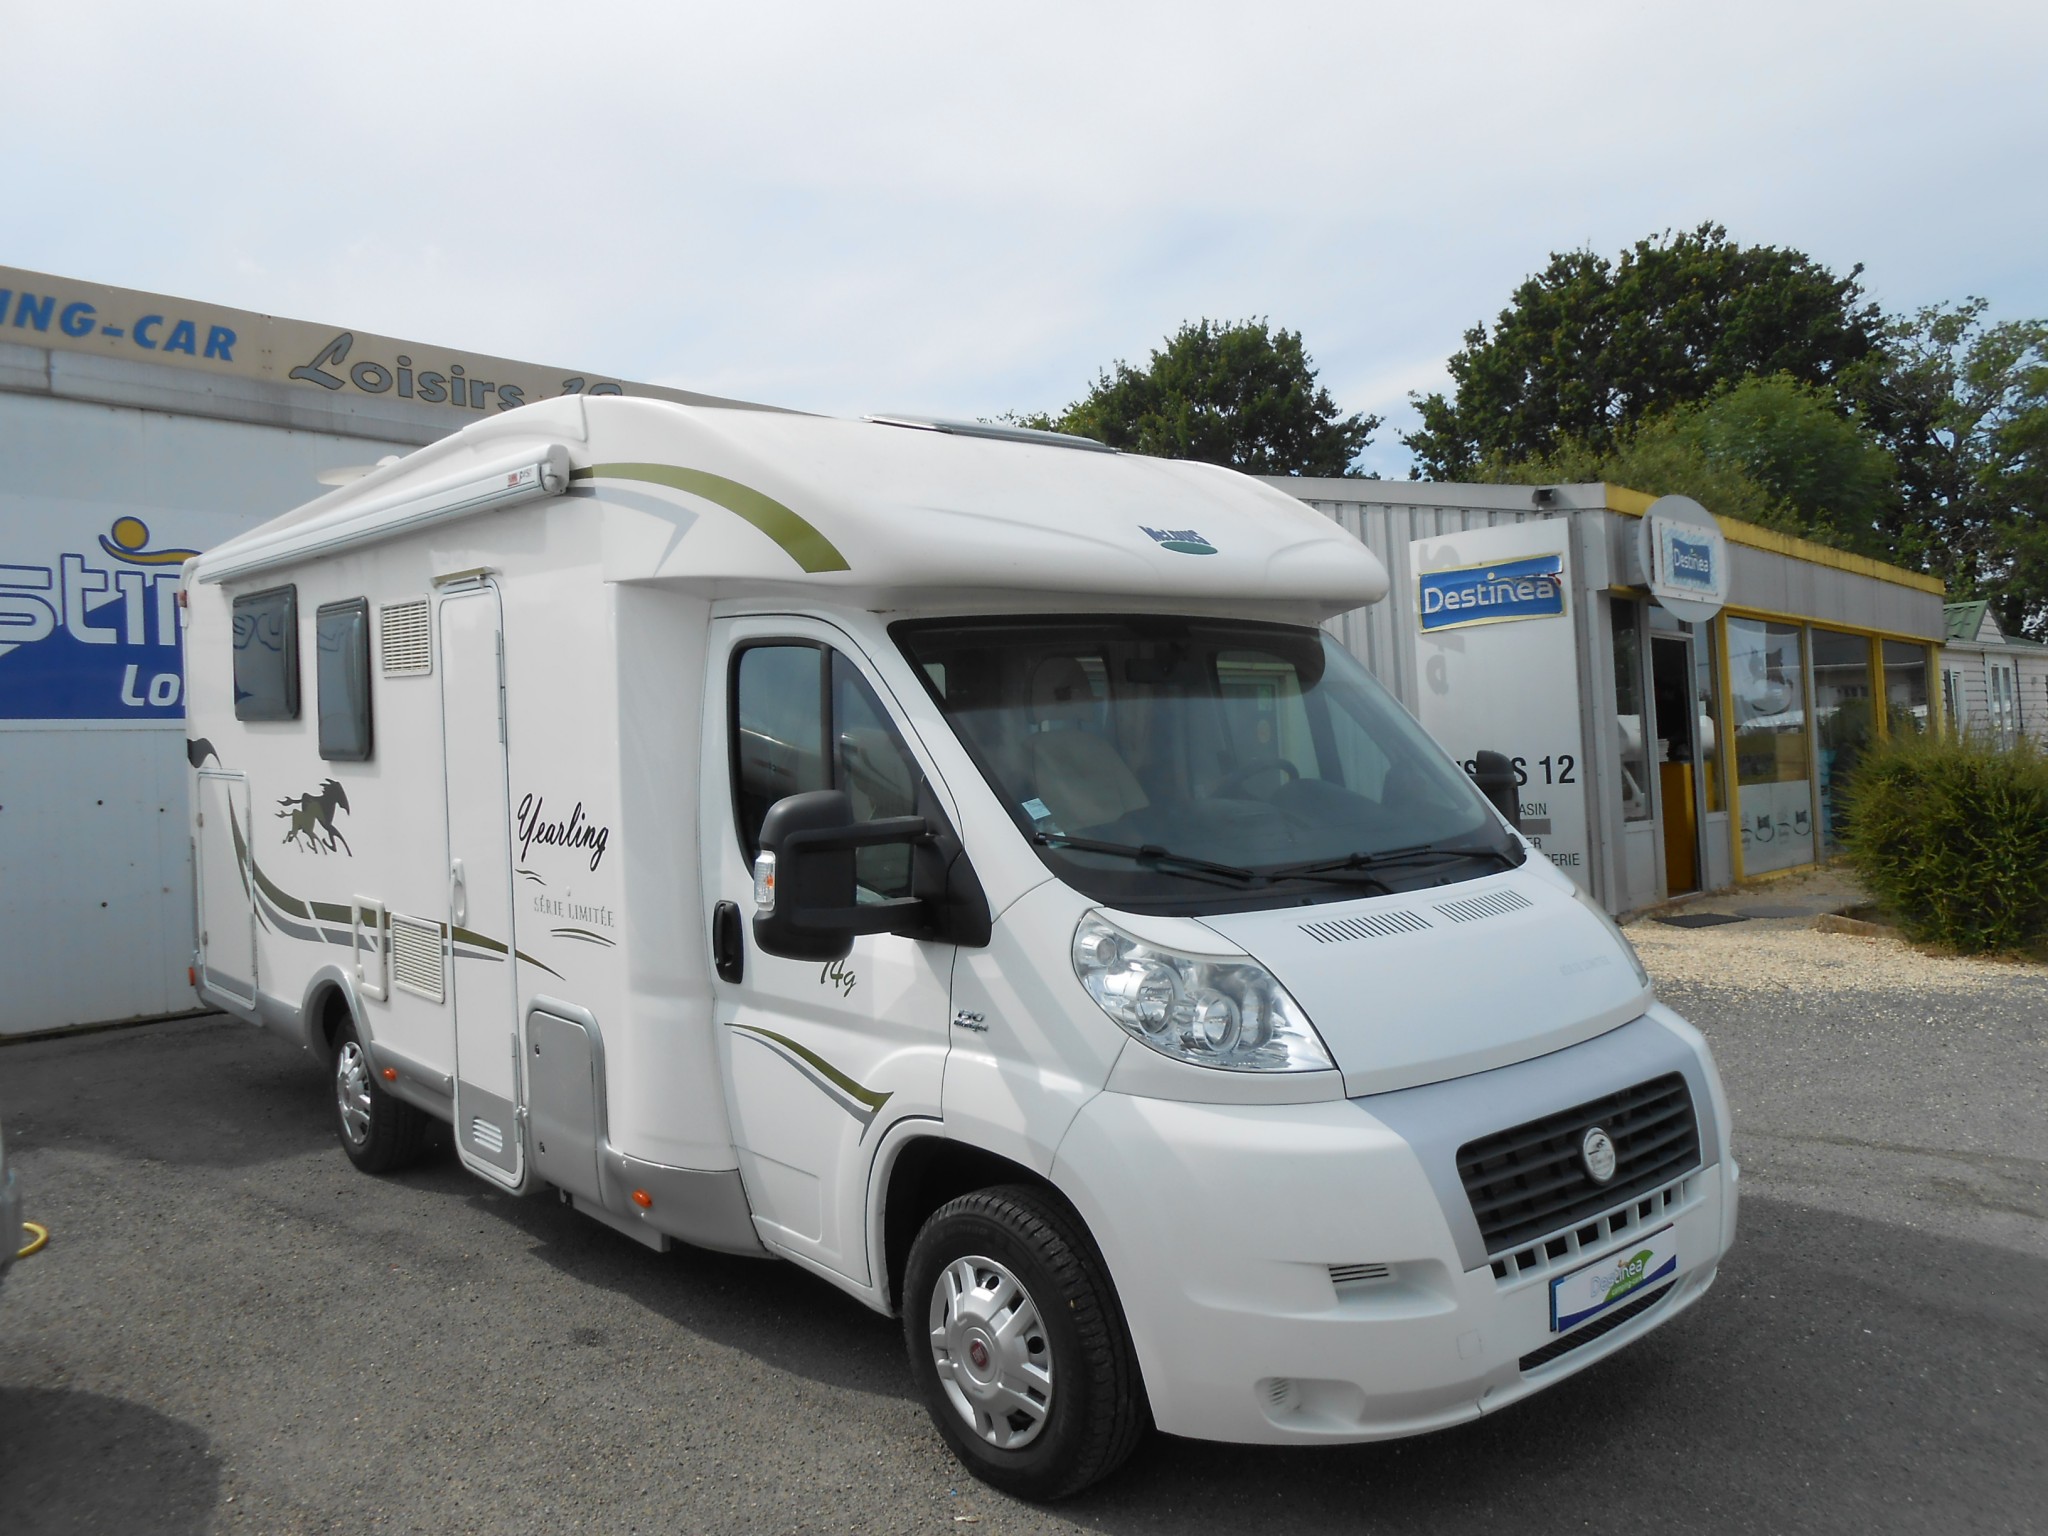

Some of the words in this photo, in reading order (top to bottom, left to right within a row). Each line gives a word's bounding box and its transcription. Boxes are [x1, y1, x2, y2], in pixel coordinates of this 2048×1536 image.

[289, 332, 526, 412] Loisirs
[1423, 572, 1555, 614] Destinea
[121, 664, 186, 707] Lo
[1538, 754, 1576, 785] 12
[517, 792, 609, 872] Yearling
[1544, 853, 1581, 867] ERIE
[534, 893, 564, 918] SÉRIE
[568, 903, 616, 928] LIMITÉE
